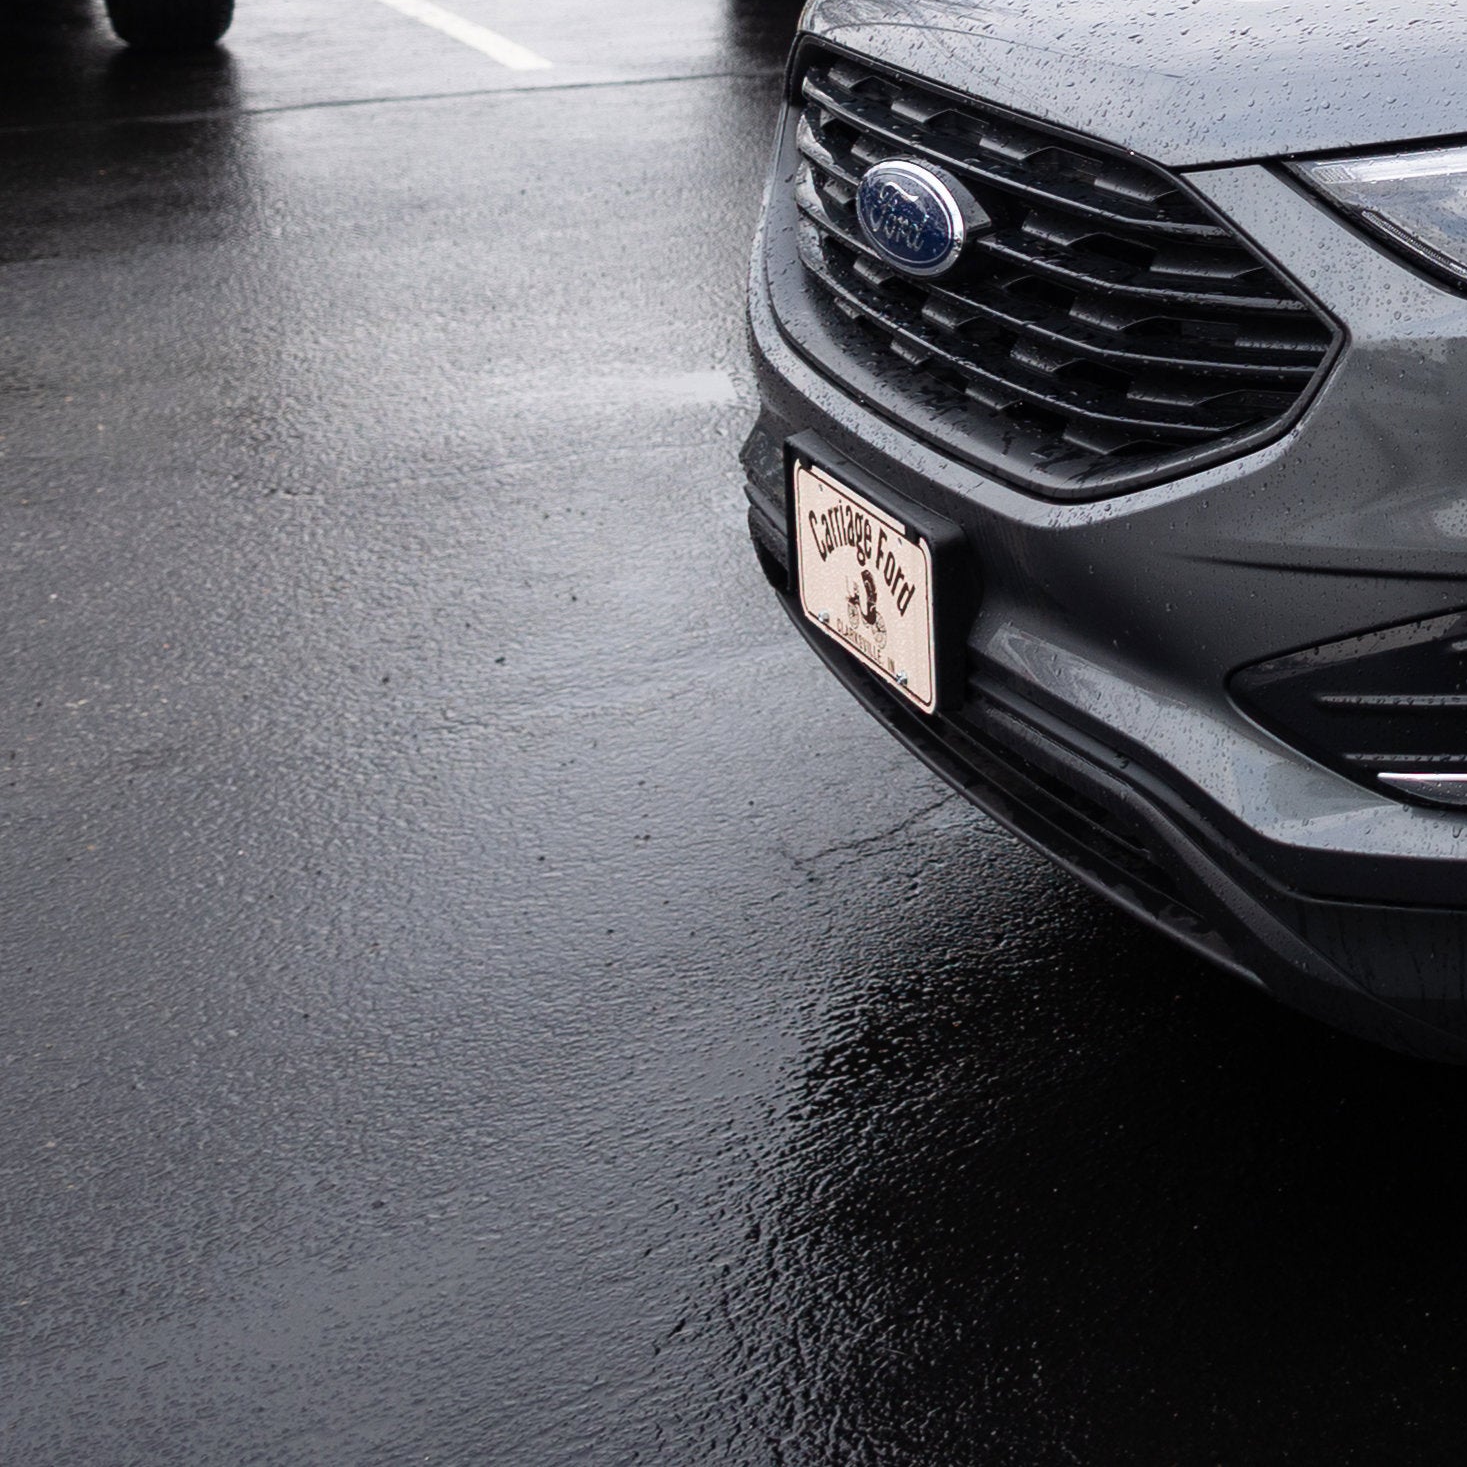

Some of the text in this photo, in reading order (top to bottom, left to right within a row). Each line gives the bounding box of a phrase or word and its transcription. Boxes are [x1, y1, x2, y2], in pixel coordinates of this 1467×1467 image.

[870, 181, 929, 252] Ford
[808, 499, 916, 617] Carriage Ford
